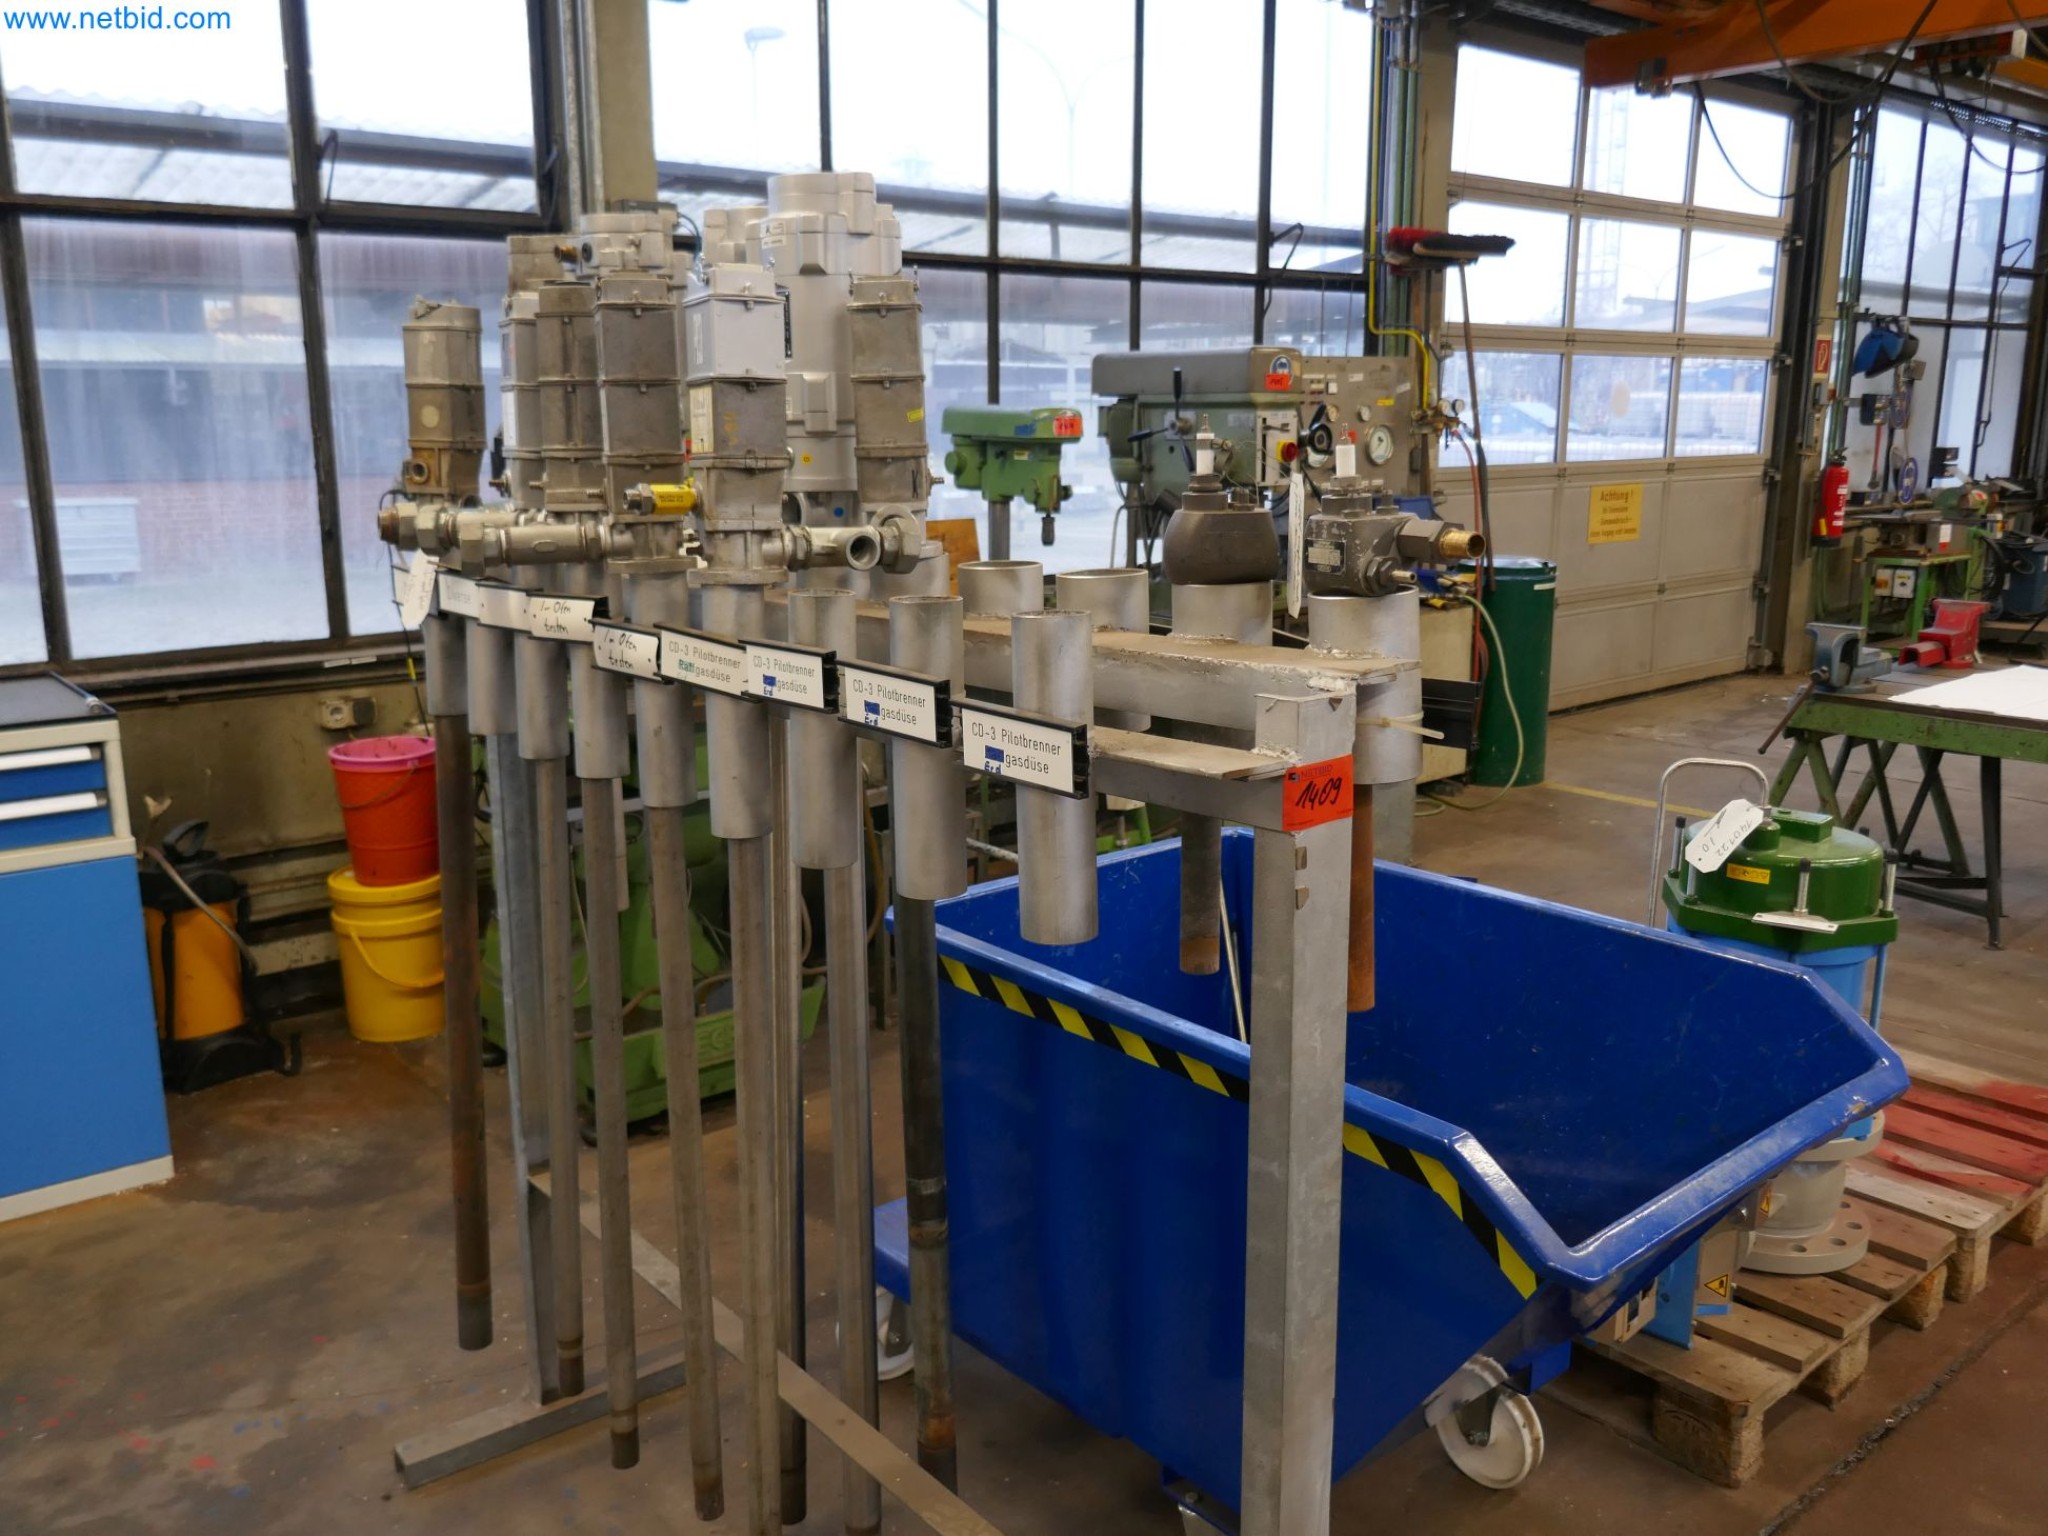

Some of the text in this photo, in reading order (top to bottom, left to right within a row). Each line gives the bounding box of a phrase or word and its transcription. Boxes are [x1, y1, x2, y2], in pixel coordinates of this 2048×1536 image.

[1600, 489, 1629, 503] Achtung
[668, 640, 741, 669] CD-3 Pilotbrenner
[753, 655, 815, 678] CD-3 Pilotbrenner
[852, 679, 926, 708] CD-3 Pilotbrenner
[971, 721, 1061, 756] CD-3 Pilotbrenner
[1295, 777, 1342, 811] 1409
